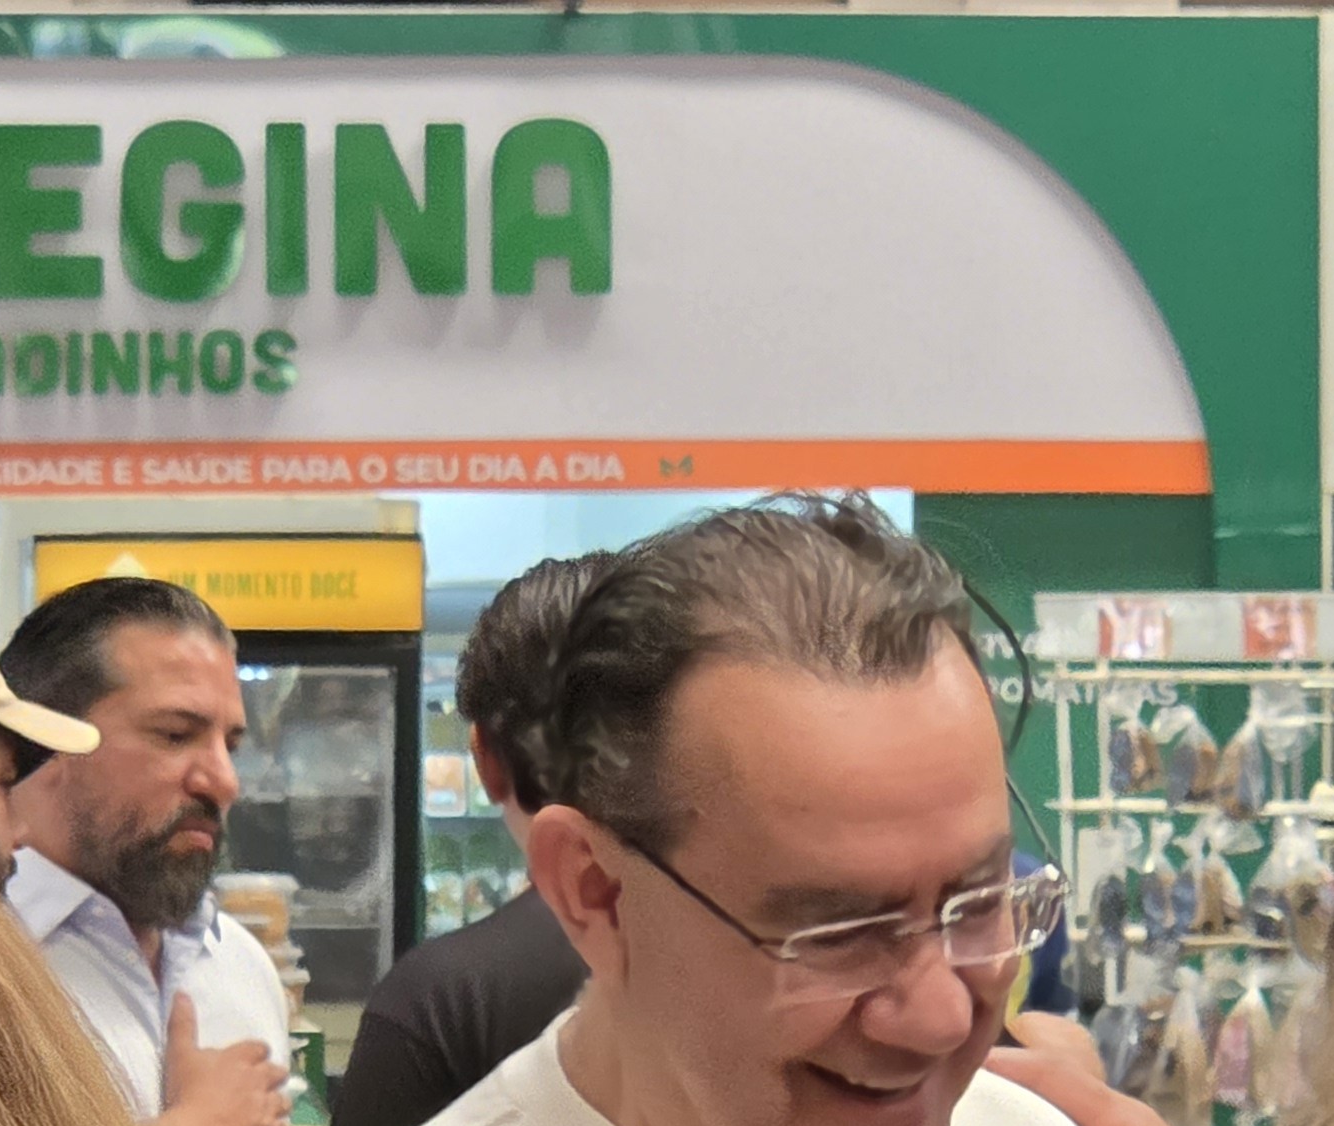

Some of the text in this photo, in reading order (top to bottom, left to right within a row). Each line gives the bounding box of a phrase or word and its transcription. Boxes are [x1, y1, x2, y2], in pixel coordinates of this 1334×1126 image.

[113, 455, 133, 485] E
[142, 452, 253, 486] SAÚDE
[261, 455, 353, 484] PARA
[360, 455, 388, 484] O
[395, 454, 459, 483] SEU
[468, 454, 528, 483] DIA
[534, 454, 558, 483] A
[566, 454, 626, 482] DIA
